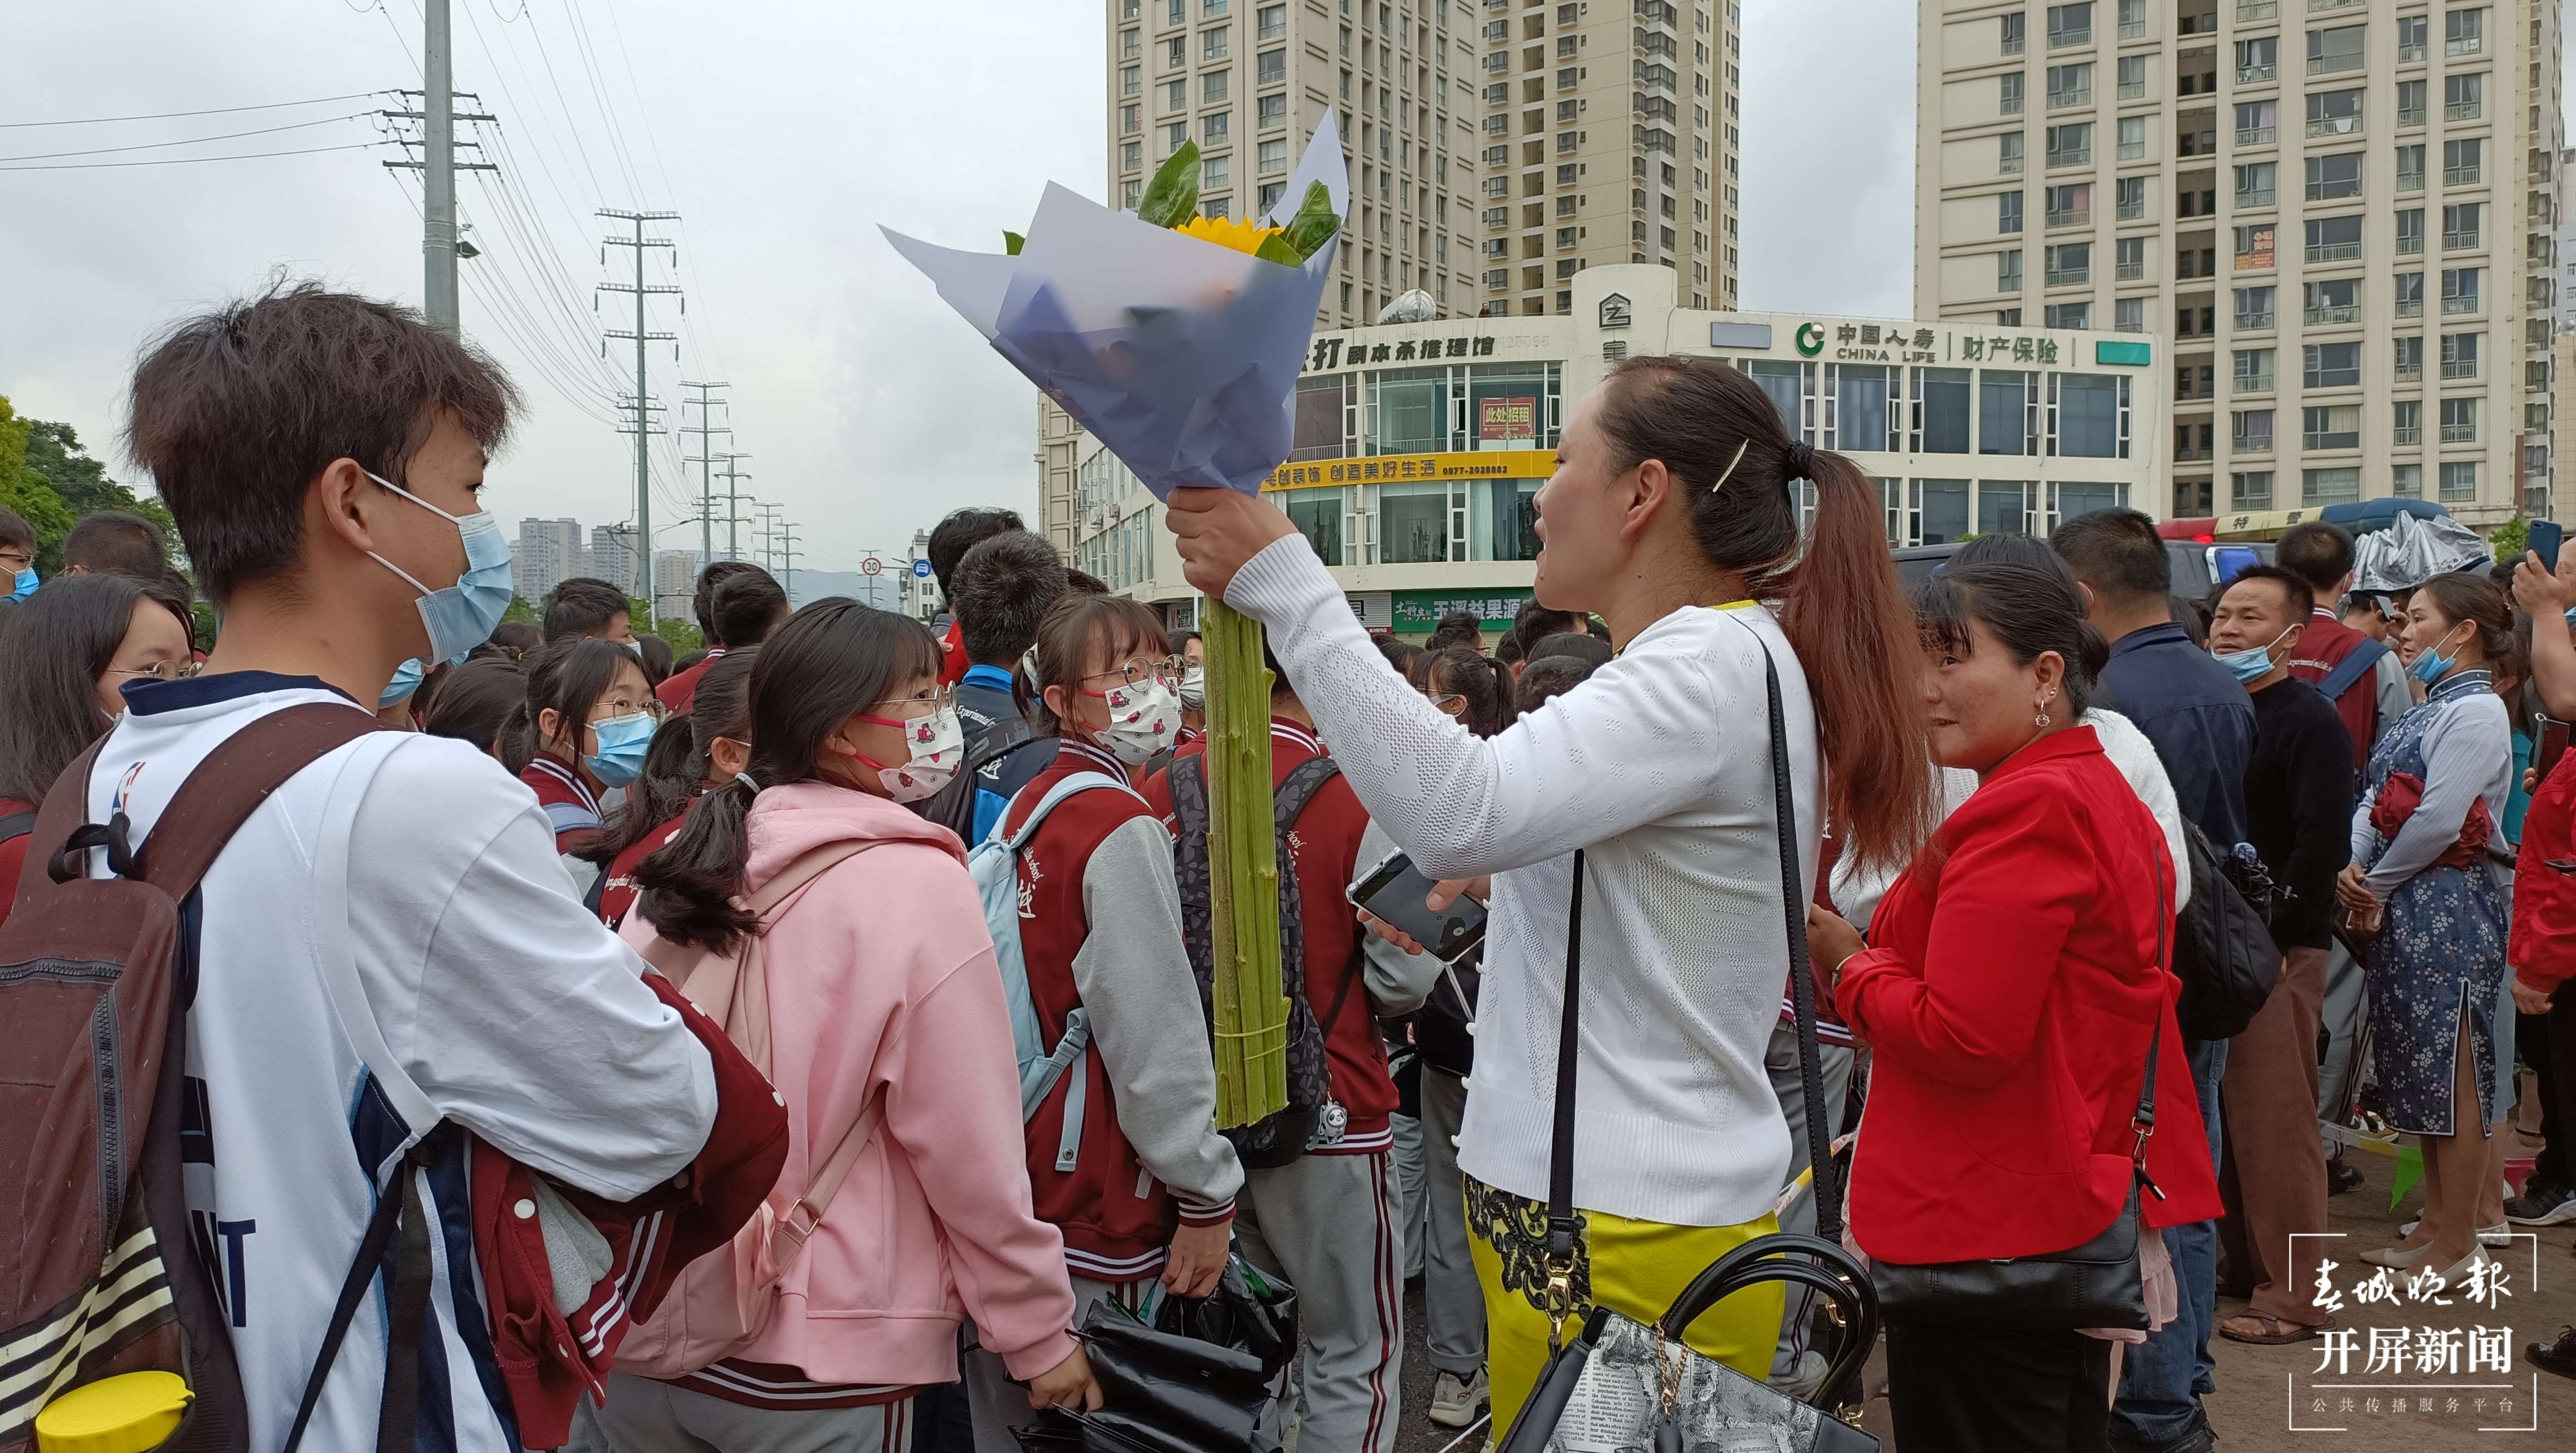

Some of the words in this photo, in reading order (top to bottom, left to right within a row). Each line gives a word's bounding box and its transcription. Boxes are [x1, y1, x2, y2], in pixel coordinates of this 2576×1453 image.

[1301, 337, 1495, 371] 打剧本杀推理馆
[1837, 323, 1935, 350] 中国人寿
[1962, 335, 2058, 364] 财产保险
[1837, 348, 1889, 362] CHINA
[1902, 351, 1935, 363] LIFE
[1485, 407, 1529, 422] 此处招租
[1330, 460, 1436, 481] 创造美好生活
[2232, 511, 2304, 530] 特警
[866, 562, 877, 571] 30
[1433, 597, 1533, 620] 玉溪益果源
[956, 705, 996, 726] Experimental
